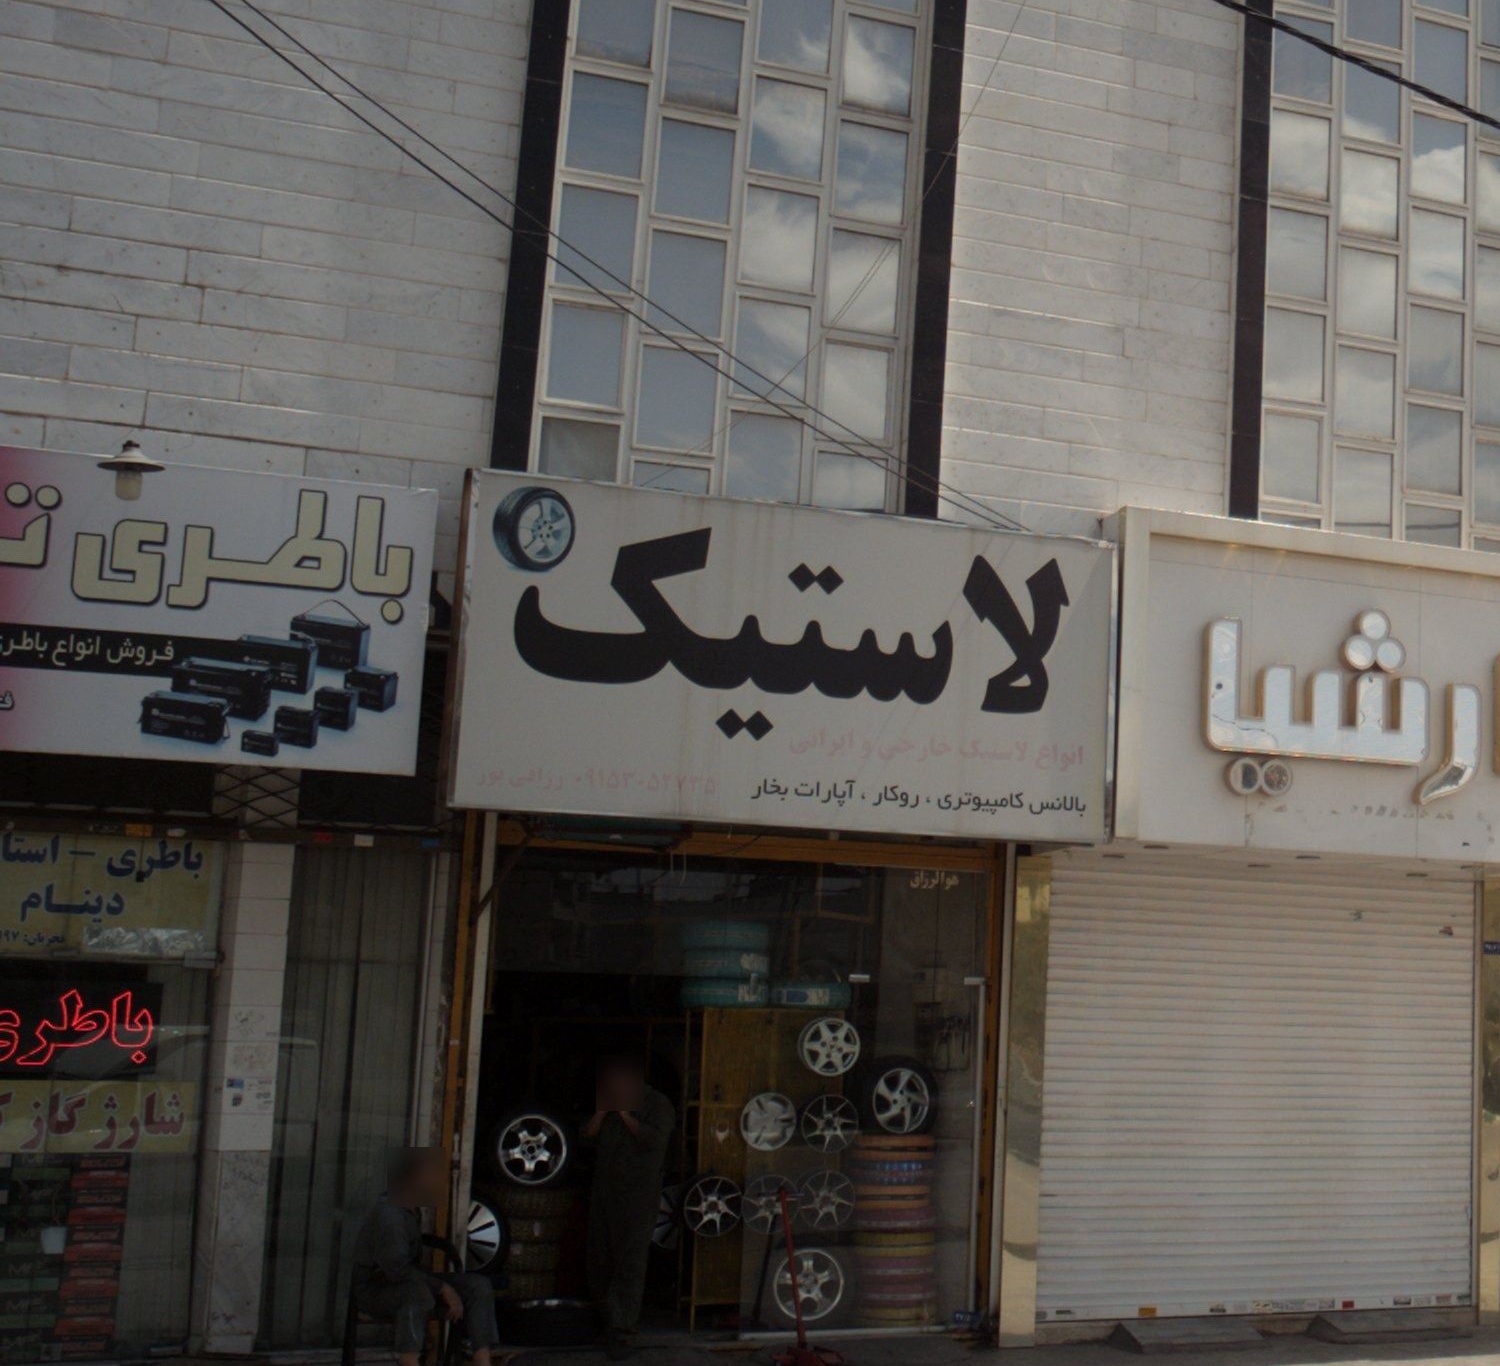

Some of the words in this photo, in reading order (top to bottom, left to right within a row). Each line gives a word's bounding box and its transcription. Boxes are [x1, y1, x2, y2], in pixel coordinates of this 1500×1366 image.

[71, 489, 414, 624] باطری
[52, 634, 100, 666] انواع
[106, 638, 174, 666] فروش
[514, 528, 1070, 741] لاستیک
[750, 777, 789, 800] بخار
[794, 779, 857, 808] آپارات
[1029, 795, 1086, 817] بالانس
[2, 832, 60, 864] استا
[106, 838, 203, 880] باطری
[21, 882, 125, 923] دینام
[19, 1091, 87, 1150] گاز
[93, 1091, 185, 1150] شارژ
